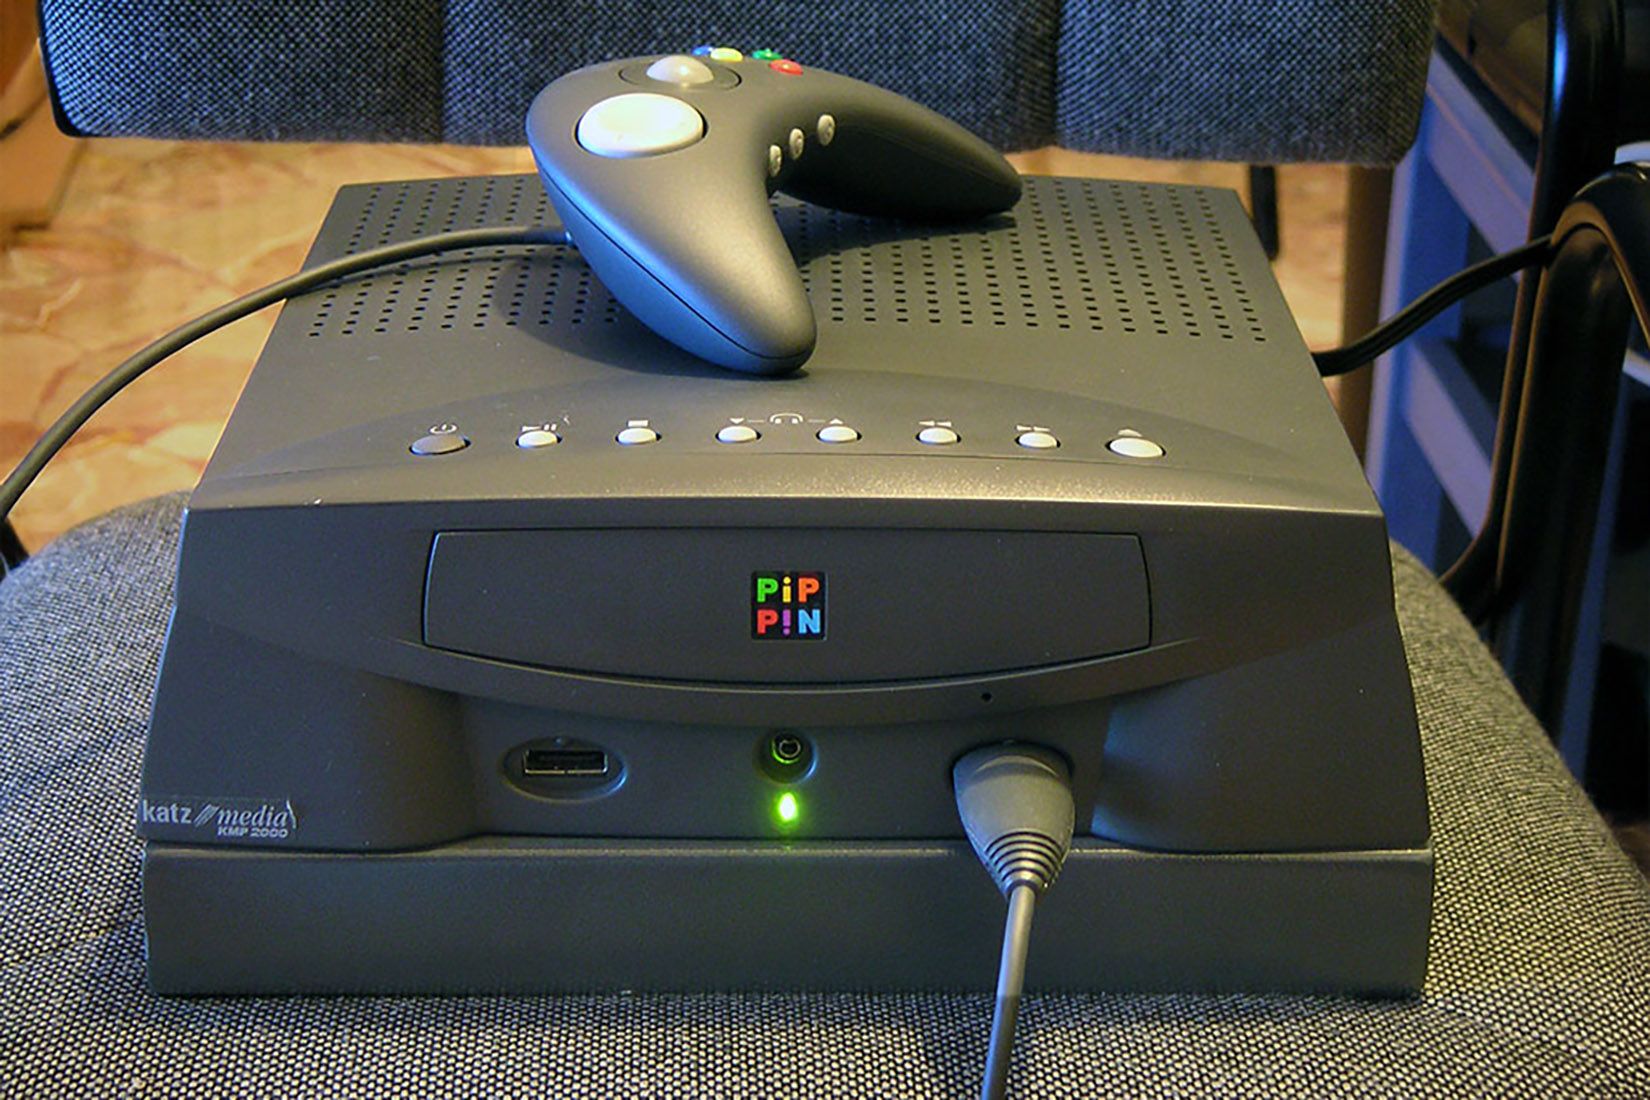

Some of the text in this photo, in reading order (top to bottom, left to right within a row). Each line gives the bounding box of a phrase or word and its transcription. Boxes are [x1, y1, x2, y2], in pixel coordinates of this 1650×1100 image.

[757, 576, 819, 603] PiP
[142, 799, 287, 828] katz media
[217, 826, 288, 838] KMP 2000
